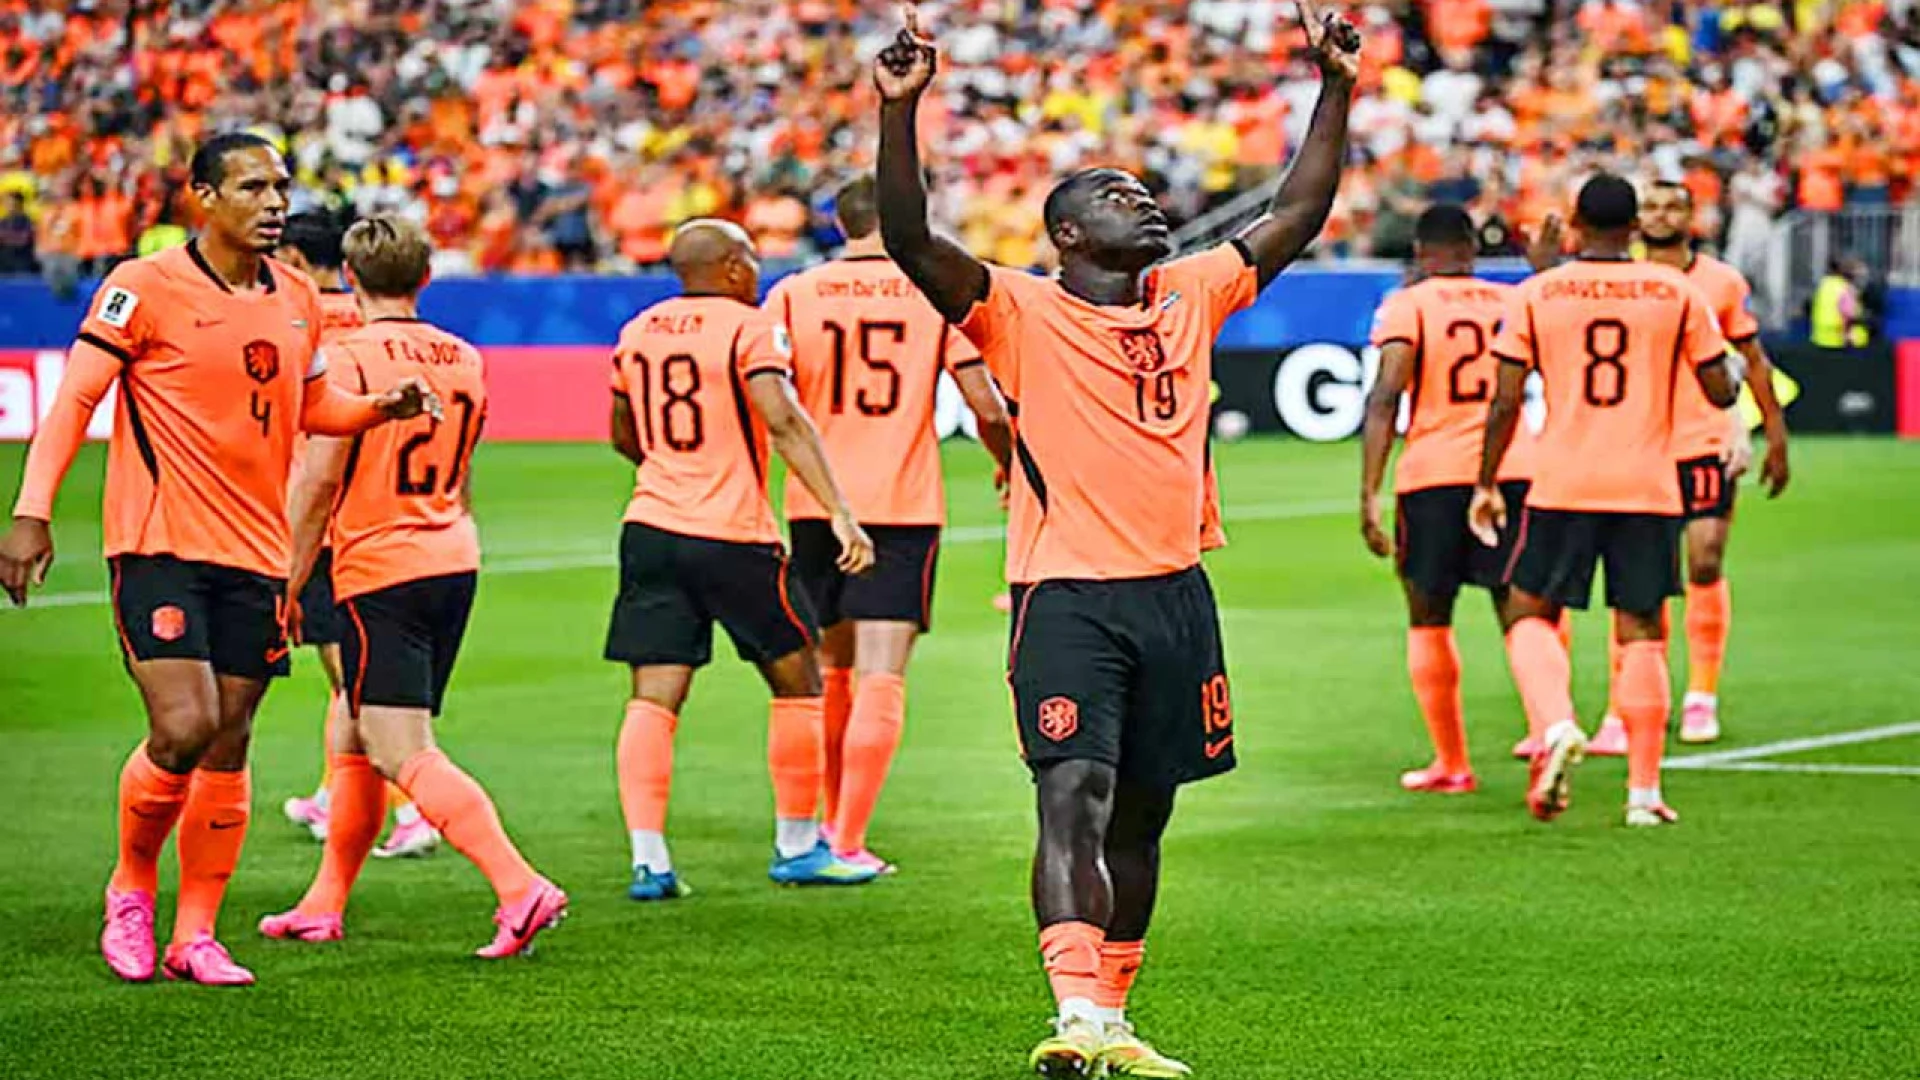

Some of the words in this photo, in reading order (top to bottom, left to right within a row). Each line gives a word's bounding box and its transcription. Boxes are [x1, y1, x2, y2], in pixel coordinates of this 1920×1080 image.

[822, 320, 906, 416] 15
[1585, 318, 1629, 408] 8
[251, 390, 271, 438] 4
[633, 352, 704, 451] 18
[1132, 370, 1176, 422] 19
[1692, 466, 1720, 499] 11
[1202, 674, 1231, 733] 19
